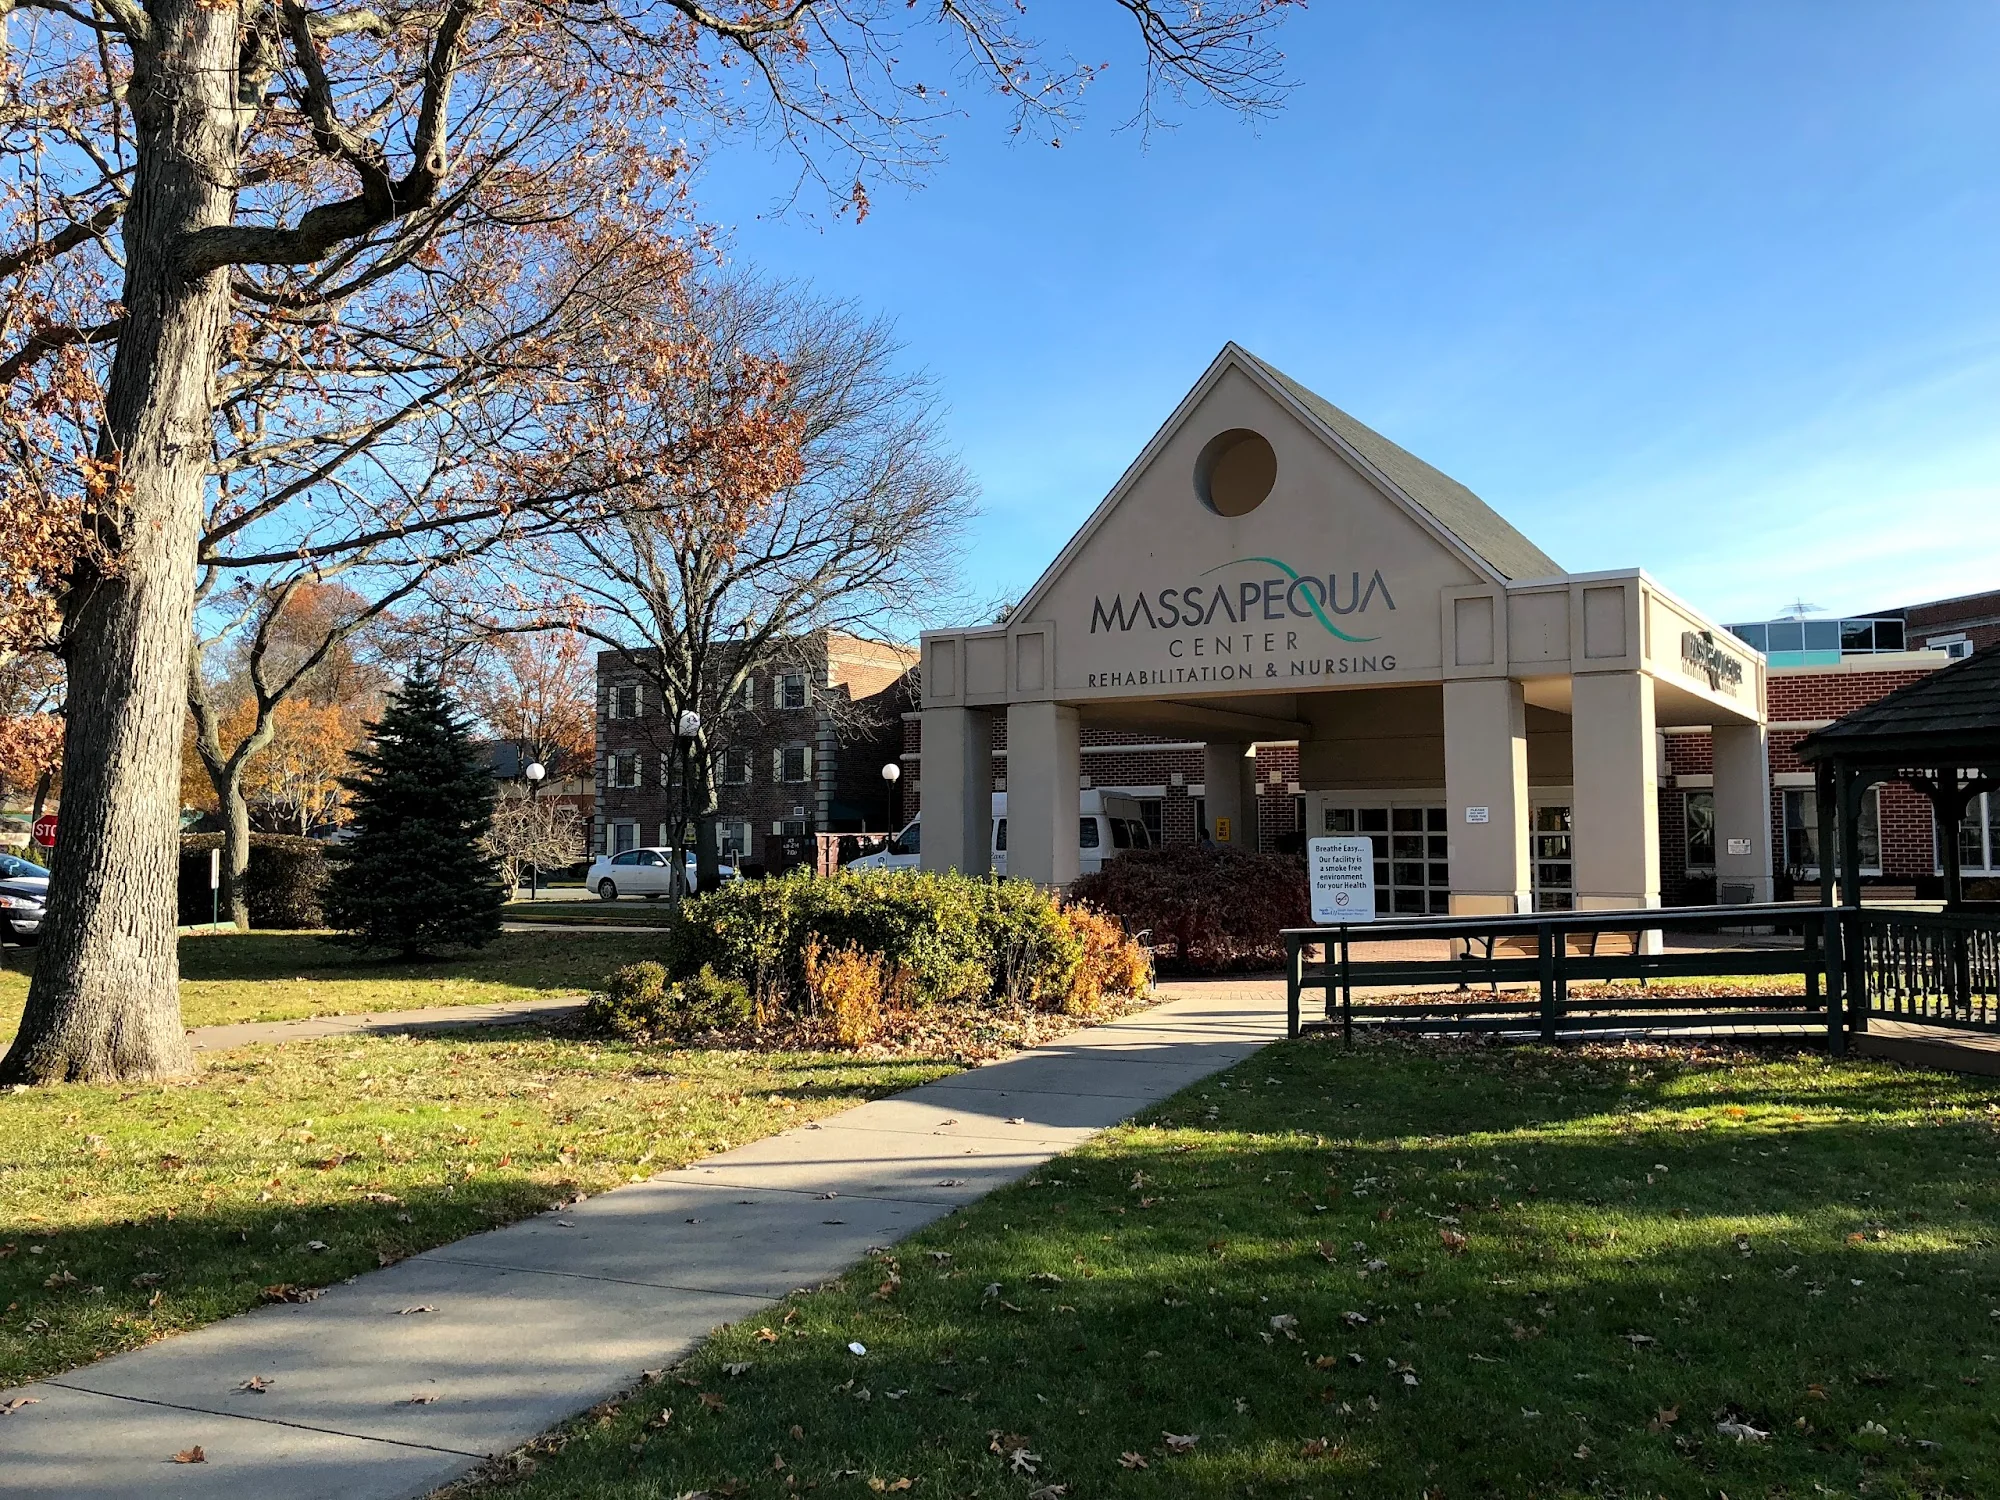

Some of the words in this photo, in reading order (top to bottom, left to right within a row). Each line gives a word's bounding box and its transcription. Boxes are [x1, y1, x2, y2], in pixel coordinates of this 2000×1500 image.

[1090, 569, 1397, 634] MASSAPEQUA
[1169, 631, 1298, 658] CENTER
[1088, 663, 1252, 688] REHABILITATION
[1265, 662, 1278, 678] &
[1291, 655, 1397, 676] NURSING
[35, 824, 57, 837] STO
[1332, 855, 1356, 864] facility
[1356, 855, 1363, 863] is
[1316, 881, 1327, 889] for
[1327, 882, 1343, 890] your
[1344, 881, 1367, 889] Health
